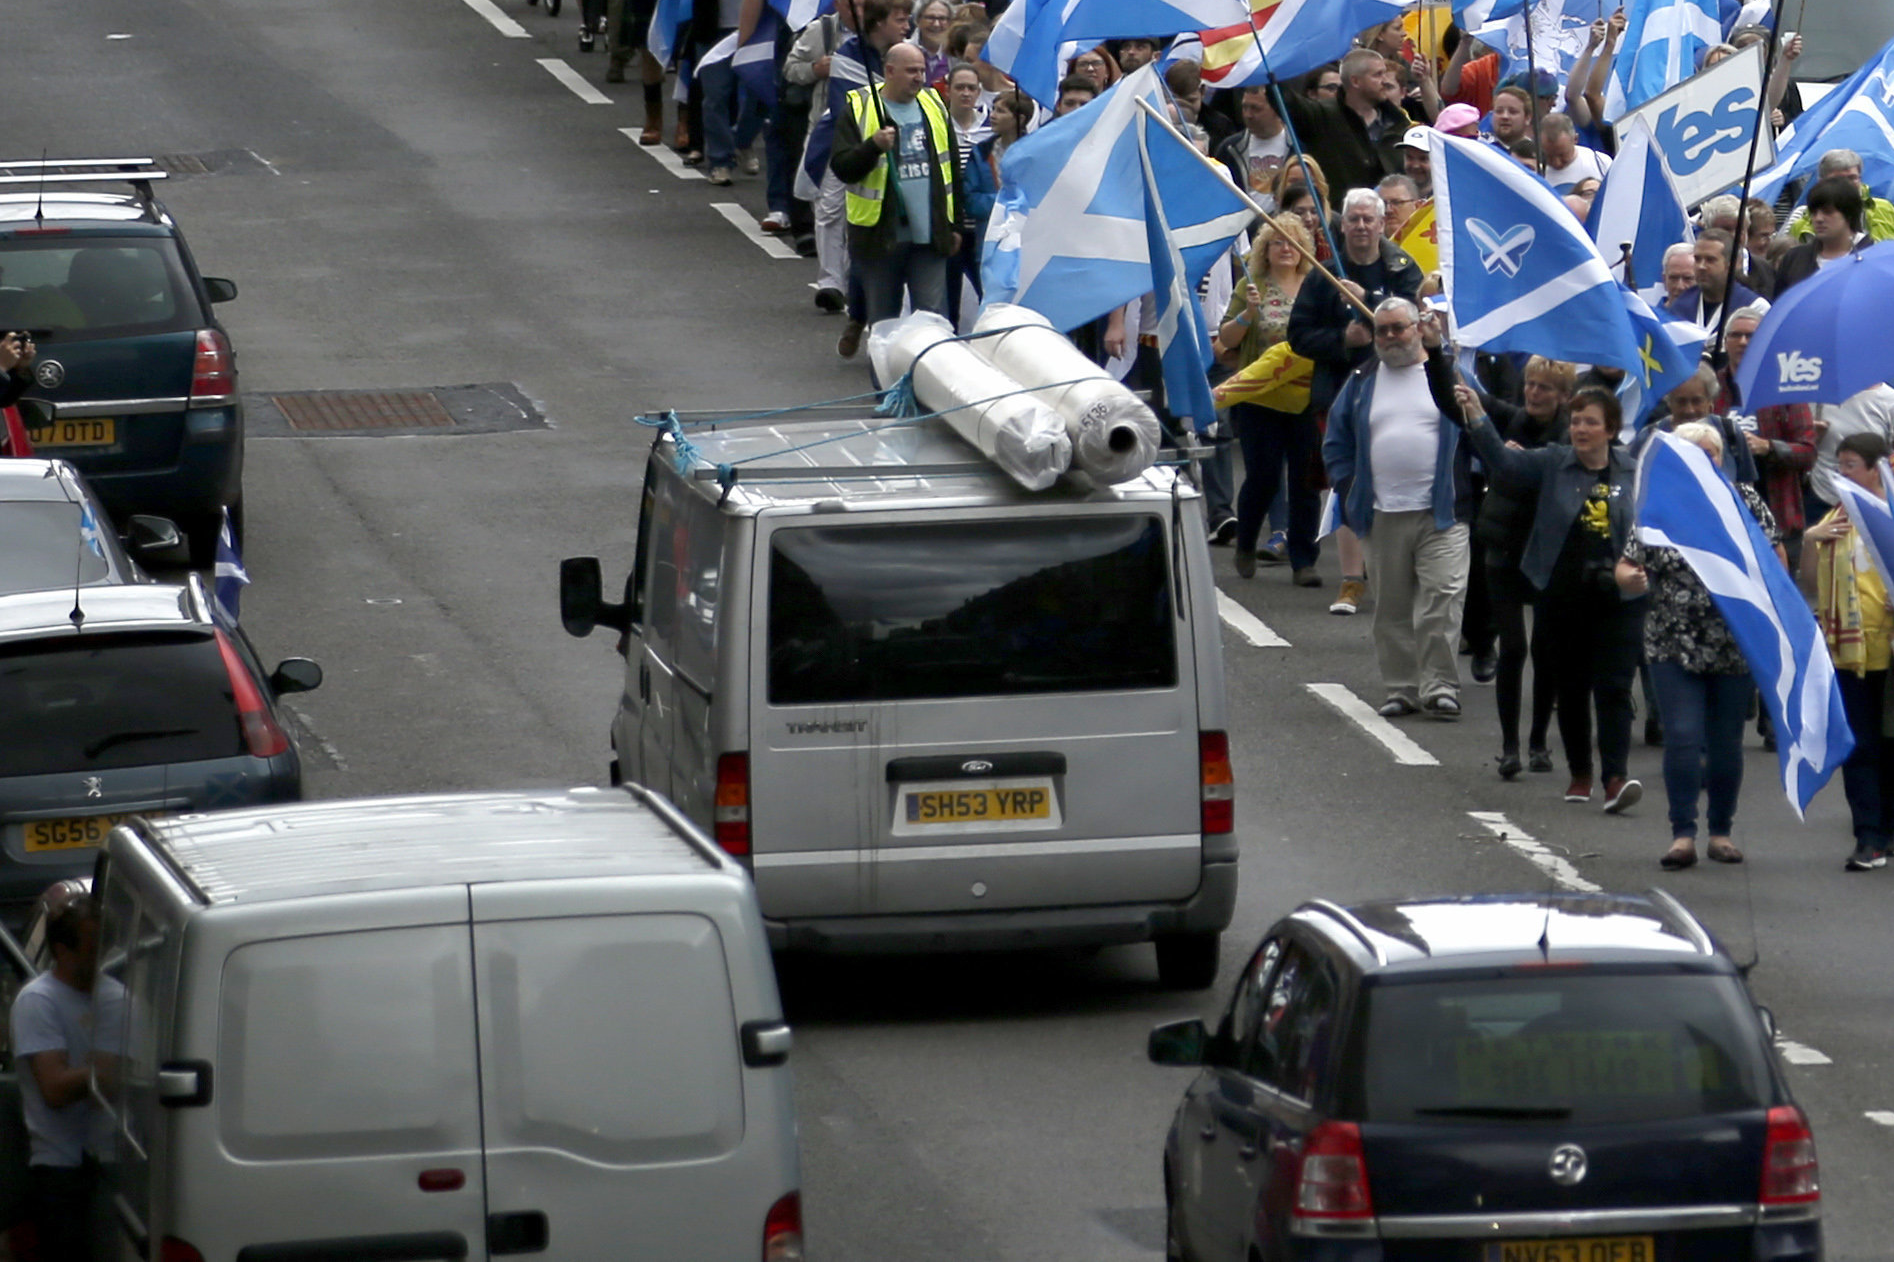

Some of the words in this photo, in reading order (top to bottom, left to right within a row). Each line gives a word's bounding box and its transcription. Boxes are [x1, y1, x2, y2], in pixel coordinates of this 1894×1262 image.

[1777, 350, 1823, 383] Yes
[63, 421, 105, 441] OTD
[786, 720, 868, 734] TRANSIT
[921, 793, 988, 818] SH53
[996, 790, 1045, 815] YRP
[34, 818, 102, 845] SG56
